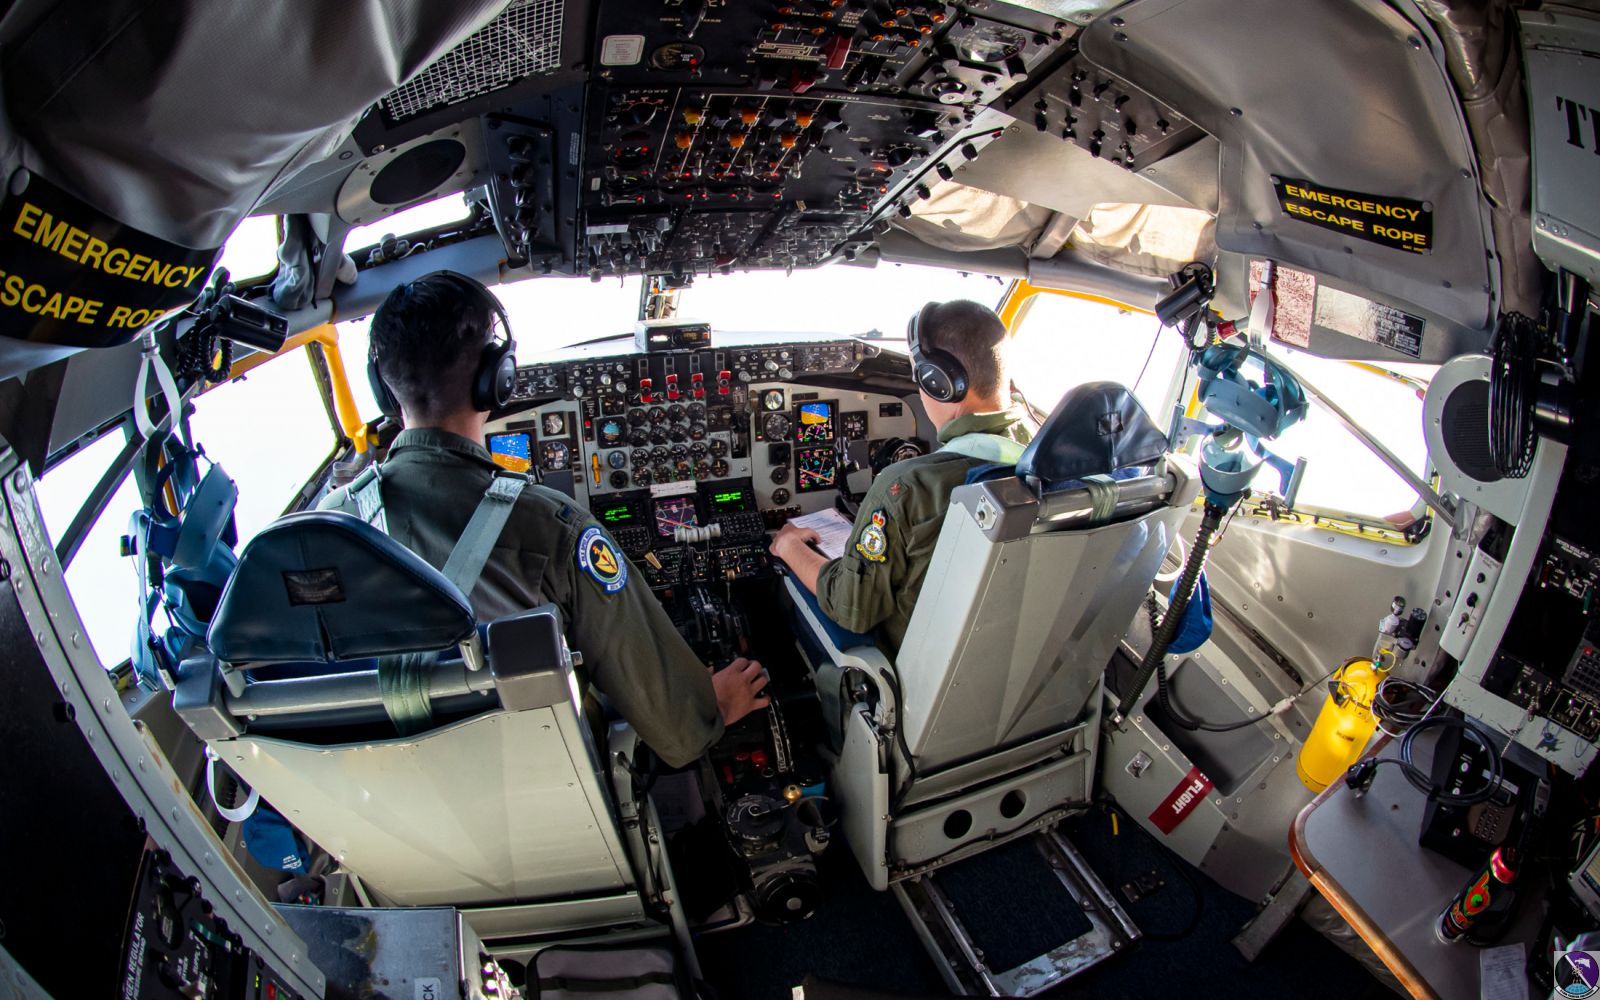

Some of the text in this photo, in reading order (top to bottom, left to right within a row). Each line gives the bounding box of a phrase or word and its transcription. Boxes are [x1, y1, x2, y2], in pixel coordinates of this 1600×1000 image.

[1285, 184, 1420, 222] EMERGENCY
[1286, 202, 1426, 245] ESCAPE ROPE
[13, 202, 205, 289] EMERGENCY
[106, 305, 167, 329] ROP
[1171, 779, 1205, 815] FLIGHT
[128, 911, 144, 974] REGULATOR
